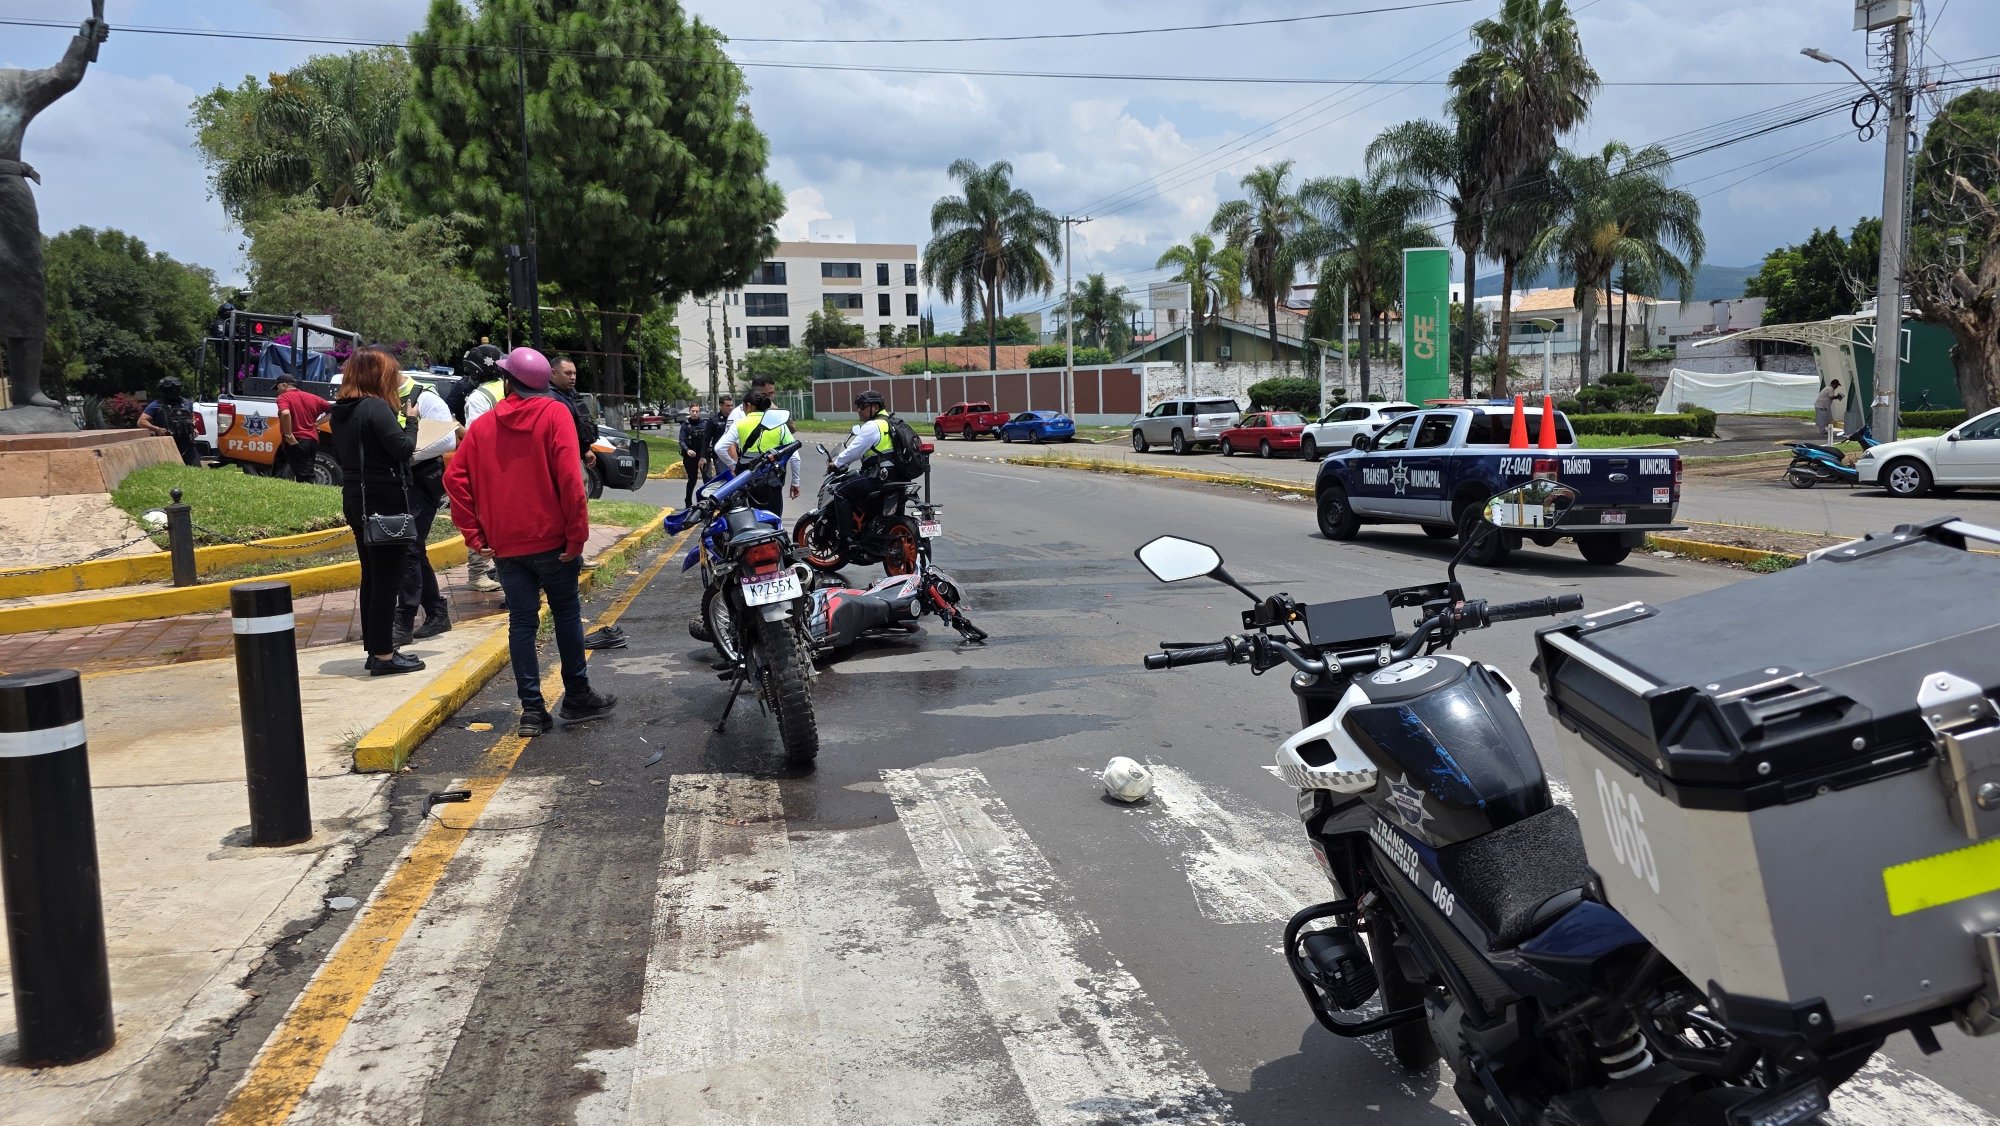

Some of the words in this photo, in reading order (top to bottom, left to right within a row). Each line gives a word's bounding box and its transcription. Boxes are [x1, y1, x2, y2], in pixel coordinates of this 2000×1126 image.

[1414, 315, 1434, 359] CFE
[228, 439, 274, 452] PZ-036
[1362, 463, 1389, 486] TRÁNSITO
[1411, 469, 1441, 489] MUNICIPAL
[1499, 457, 1533, 475] PZ-040
[1562, 456, 1591, 475] TRÁNSITO
[1639, 458, 1671, 475] MUNICIPAL
[1377, 817, 1419, 868] TRÁNSITO
[1595, 768, 1660, 894] 066
[1370, 827, 1419, 886] MUNICIPAL
[1432, 880, 1455, 917] 066
